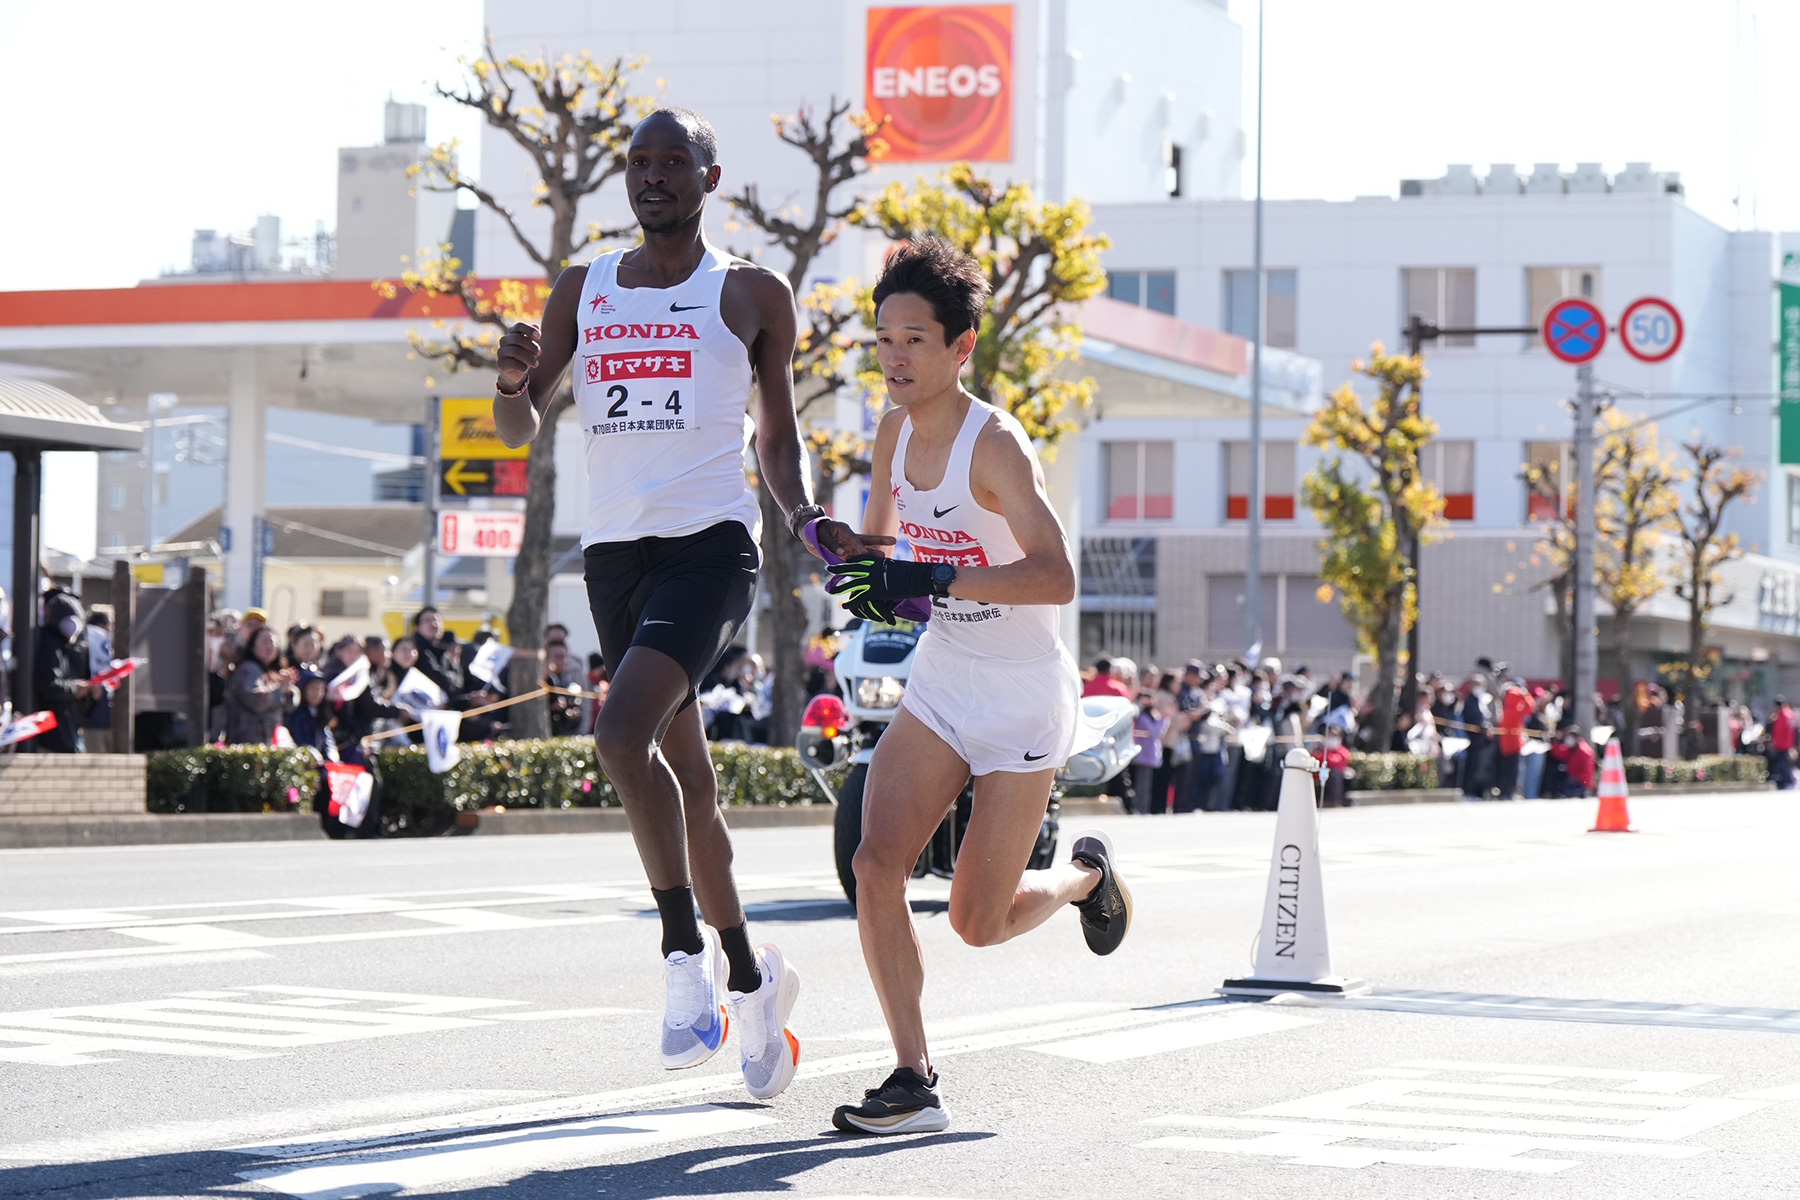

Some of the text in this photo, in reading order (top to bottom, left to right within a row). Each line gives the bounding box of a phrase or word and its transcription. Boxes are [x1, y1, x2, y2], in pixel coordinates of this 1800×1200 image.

[873, 64, 1001, 98] ENEOS
[584, 324, 700, 344] HONDA
[1632, 314, 1671, 346] 50
[606, 356, 685, 375] ヤマザキ
[592, 419, 685, 435] 第70回全日本実業団駅伝
[474, 529, 511, 549] 400
[1275, 844, 1302, 959] CITIZEN
